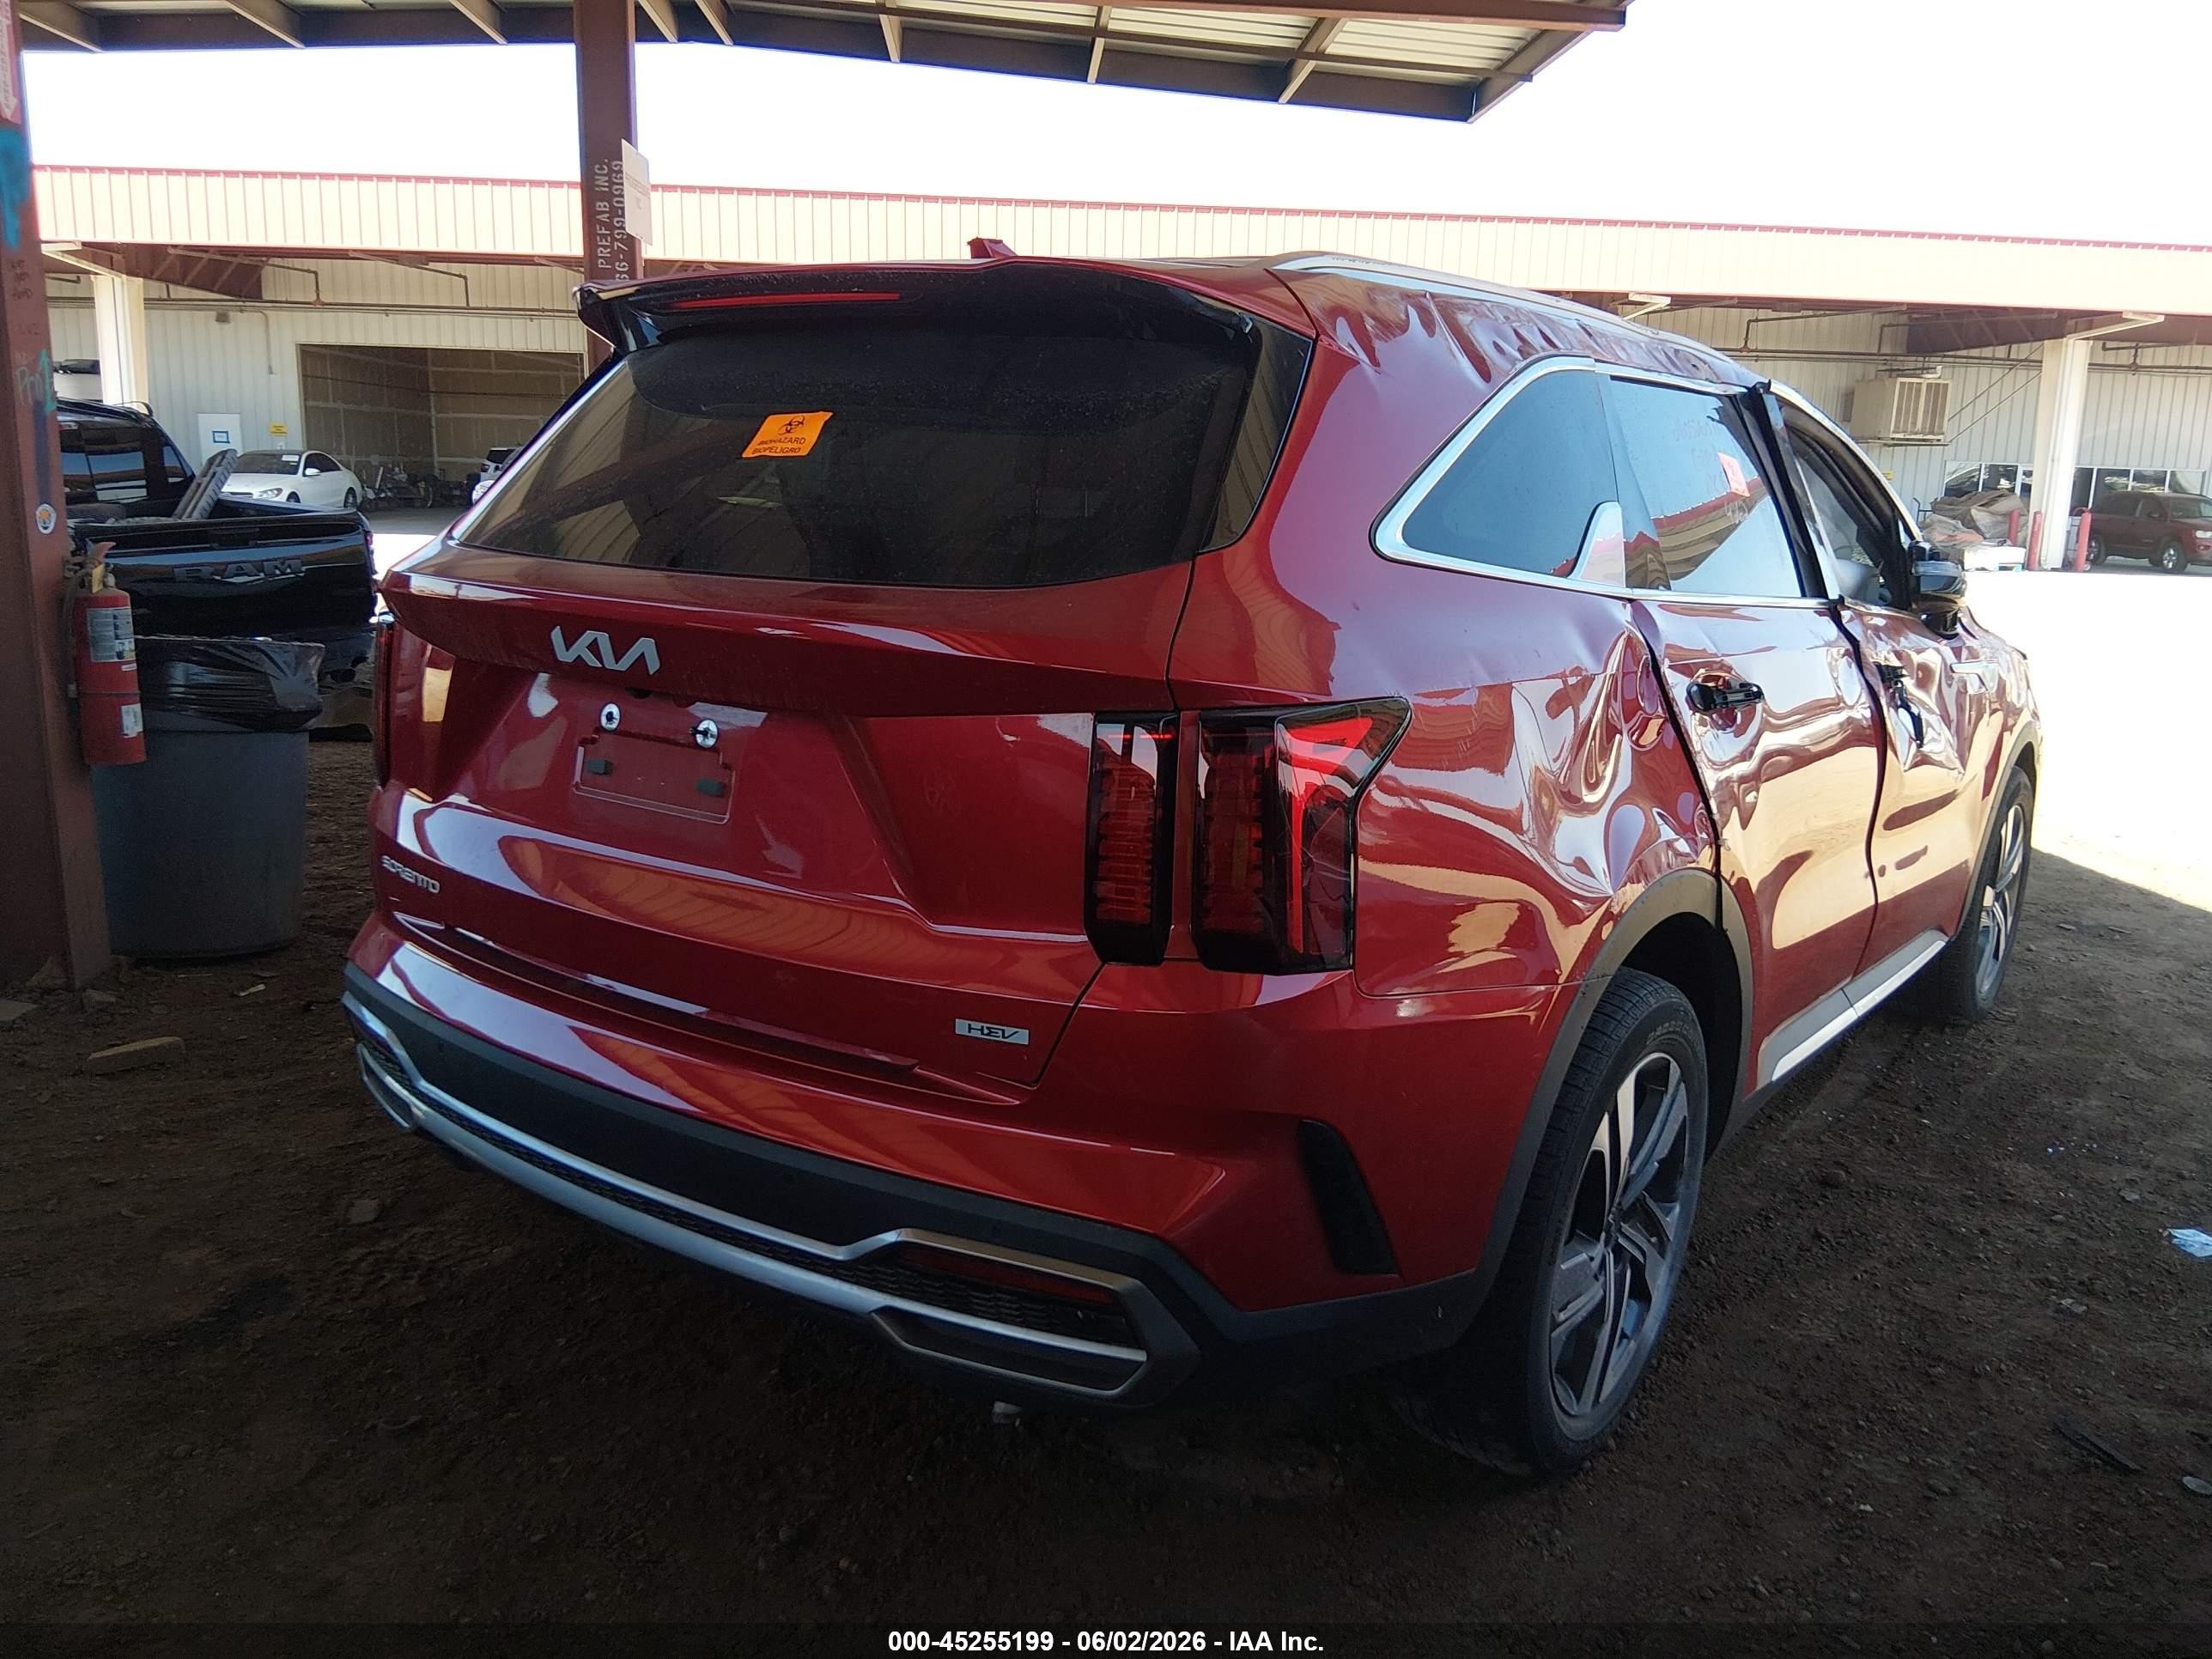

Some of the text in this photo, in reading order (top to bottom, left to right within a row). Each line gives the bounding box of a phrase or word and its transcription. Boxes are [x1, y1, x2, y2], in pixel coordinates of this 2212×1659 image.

[593, 159, 612, 269] PREFAB INC.
[751, 446, 802, 455] BIOPELIGRO
[757, 437, 806, 447] BIOHAZARD
[173, 559, 303, 582] RAM
[550, 625, 660, 676] KIA
[967, 1023, 1020, 1040] HEV
